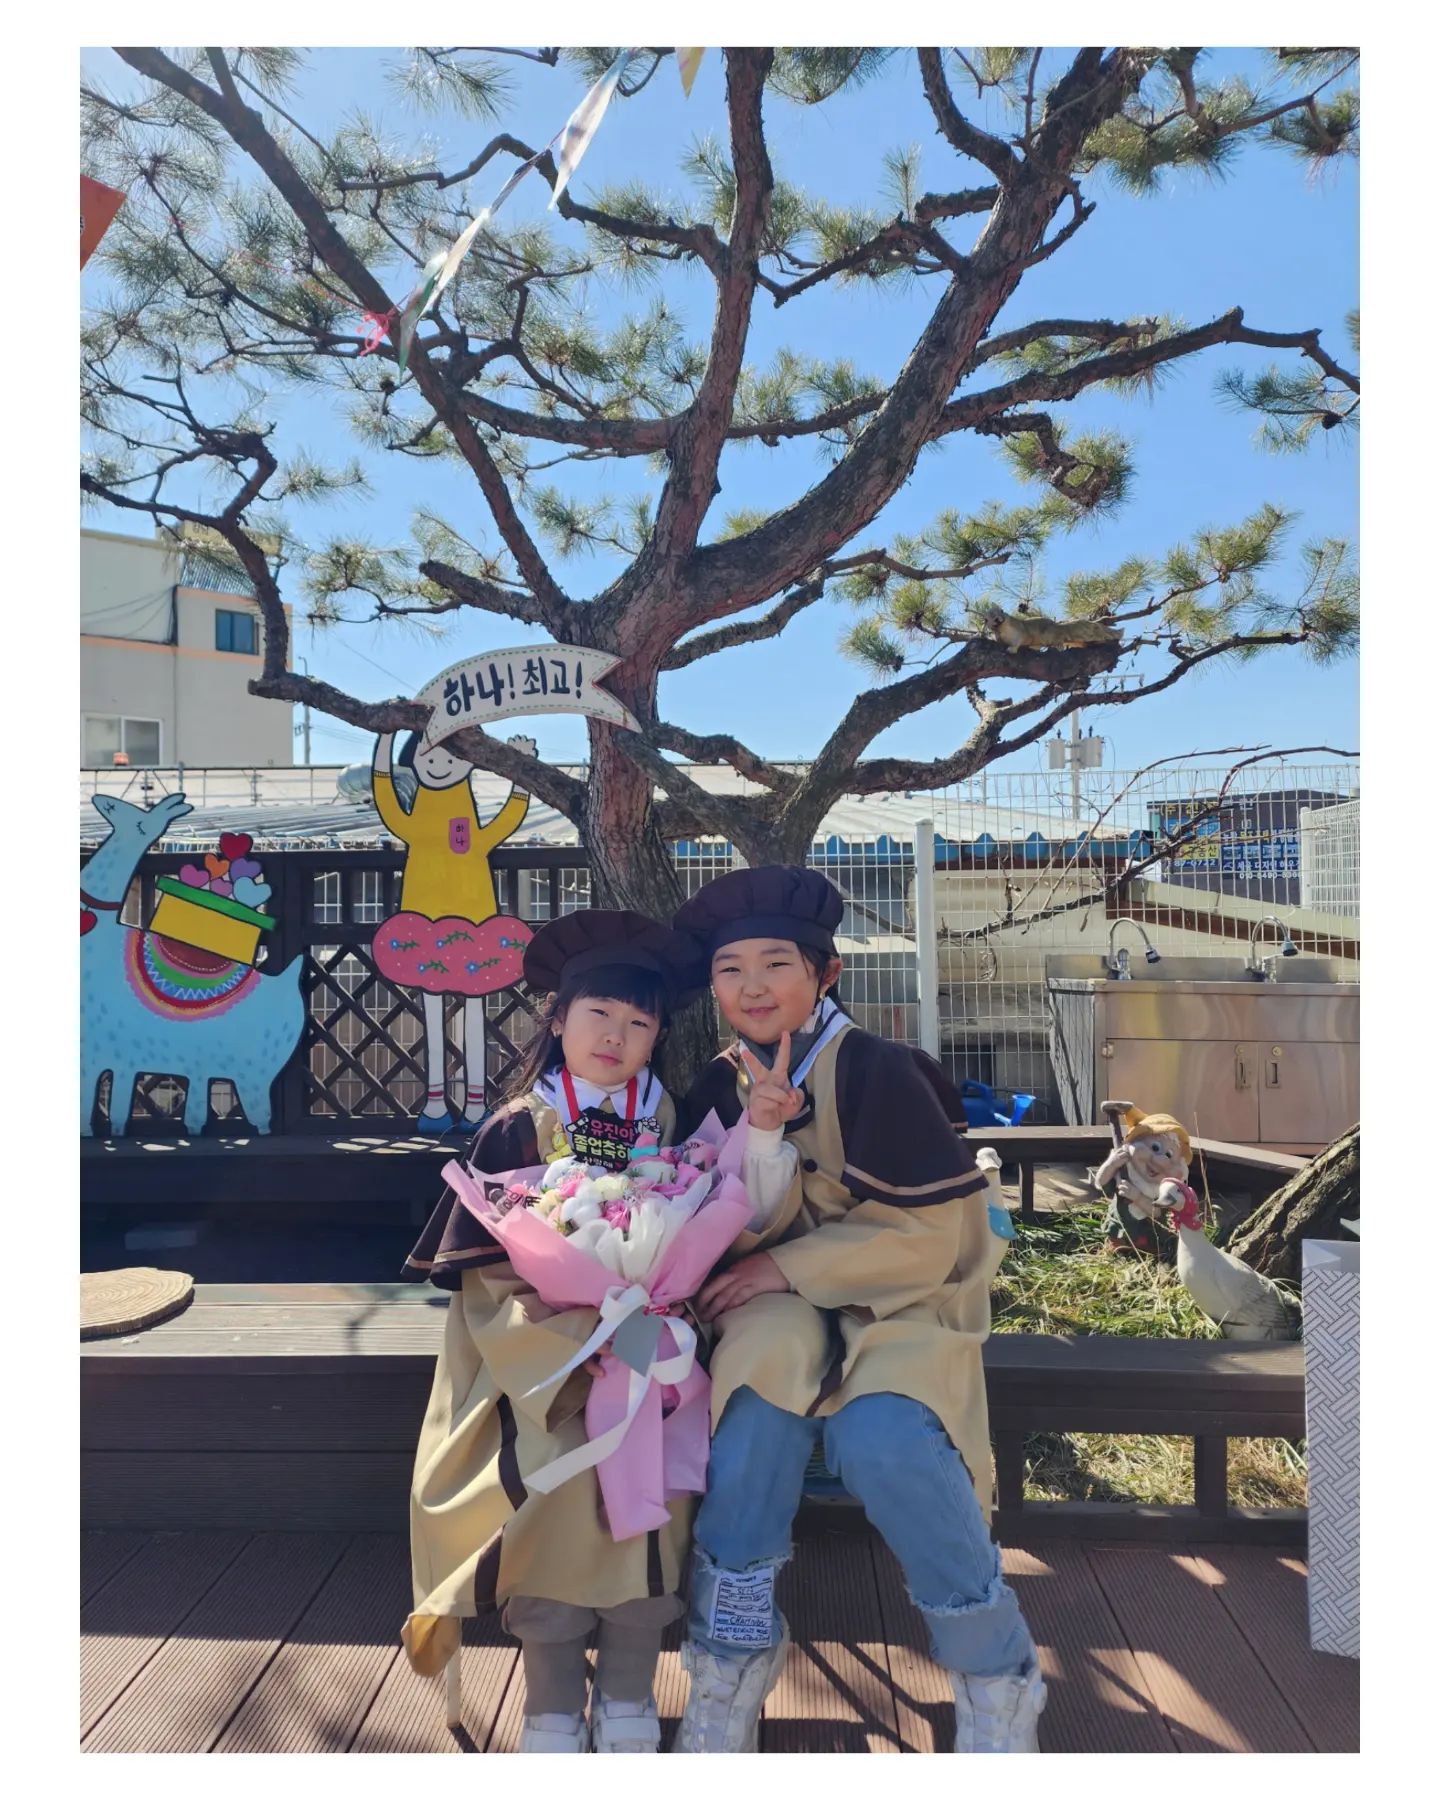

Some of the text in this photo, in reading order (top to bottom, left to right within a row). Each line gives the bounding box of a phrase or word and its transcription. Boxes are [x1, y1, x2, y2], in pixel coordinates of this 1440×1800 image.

[444, 656, 582, 716] 하나! 최고!
[456, 824, 464, 846] 하나
[591, 1120, 635, 1142] 유진아
